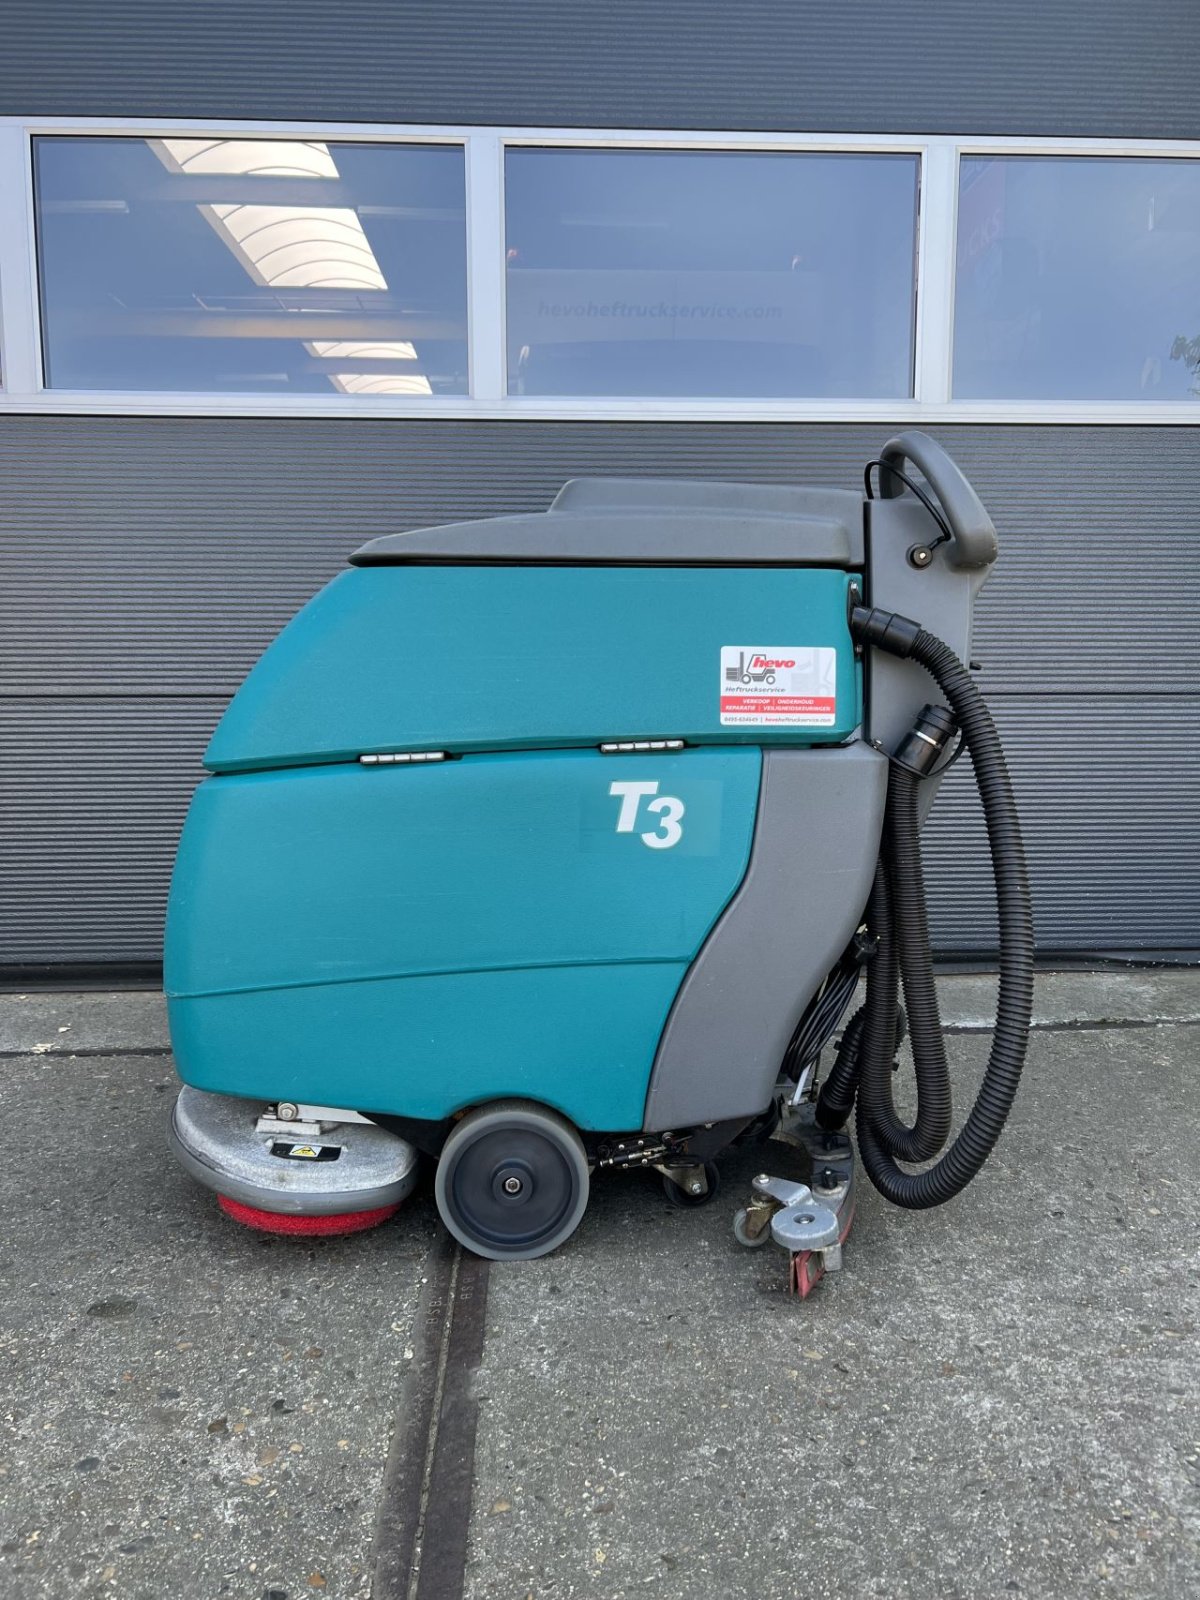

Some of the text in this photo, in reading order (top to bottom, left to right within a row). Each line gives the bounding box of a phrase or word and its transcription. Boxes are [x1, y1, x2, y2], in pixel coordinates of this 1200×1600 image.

[537, 300, 784, 319] hevoheftruckservice.com
[753, 657, 796, 669] hevo
[609, 781, 685, 849] T3
